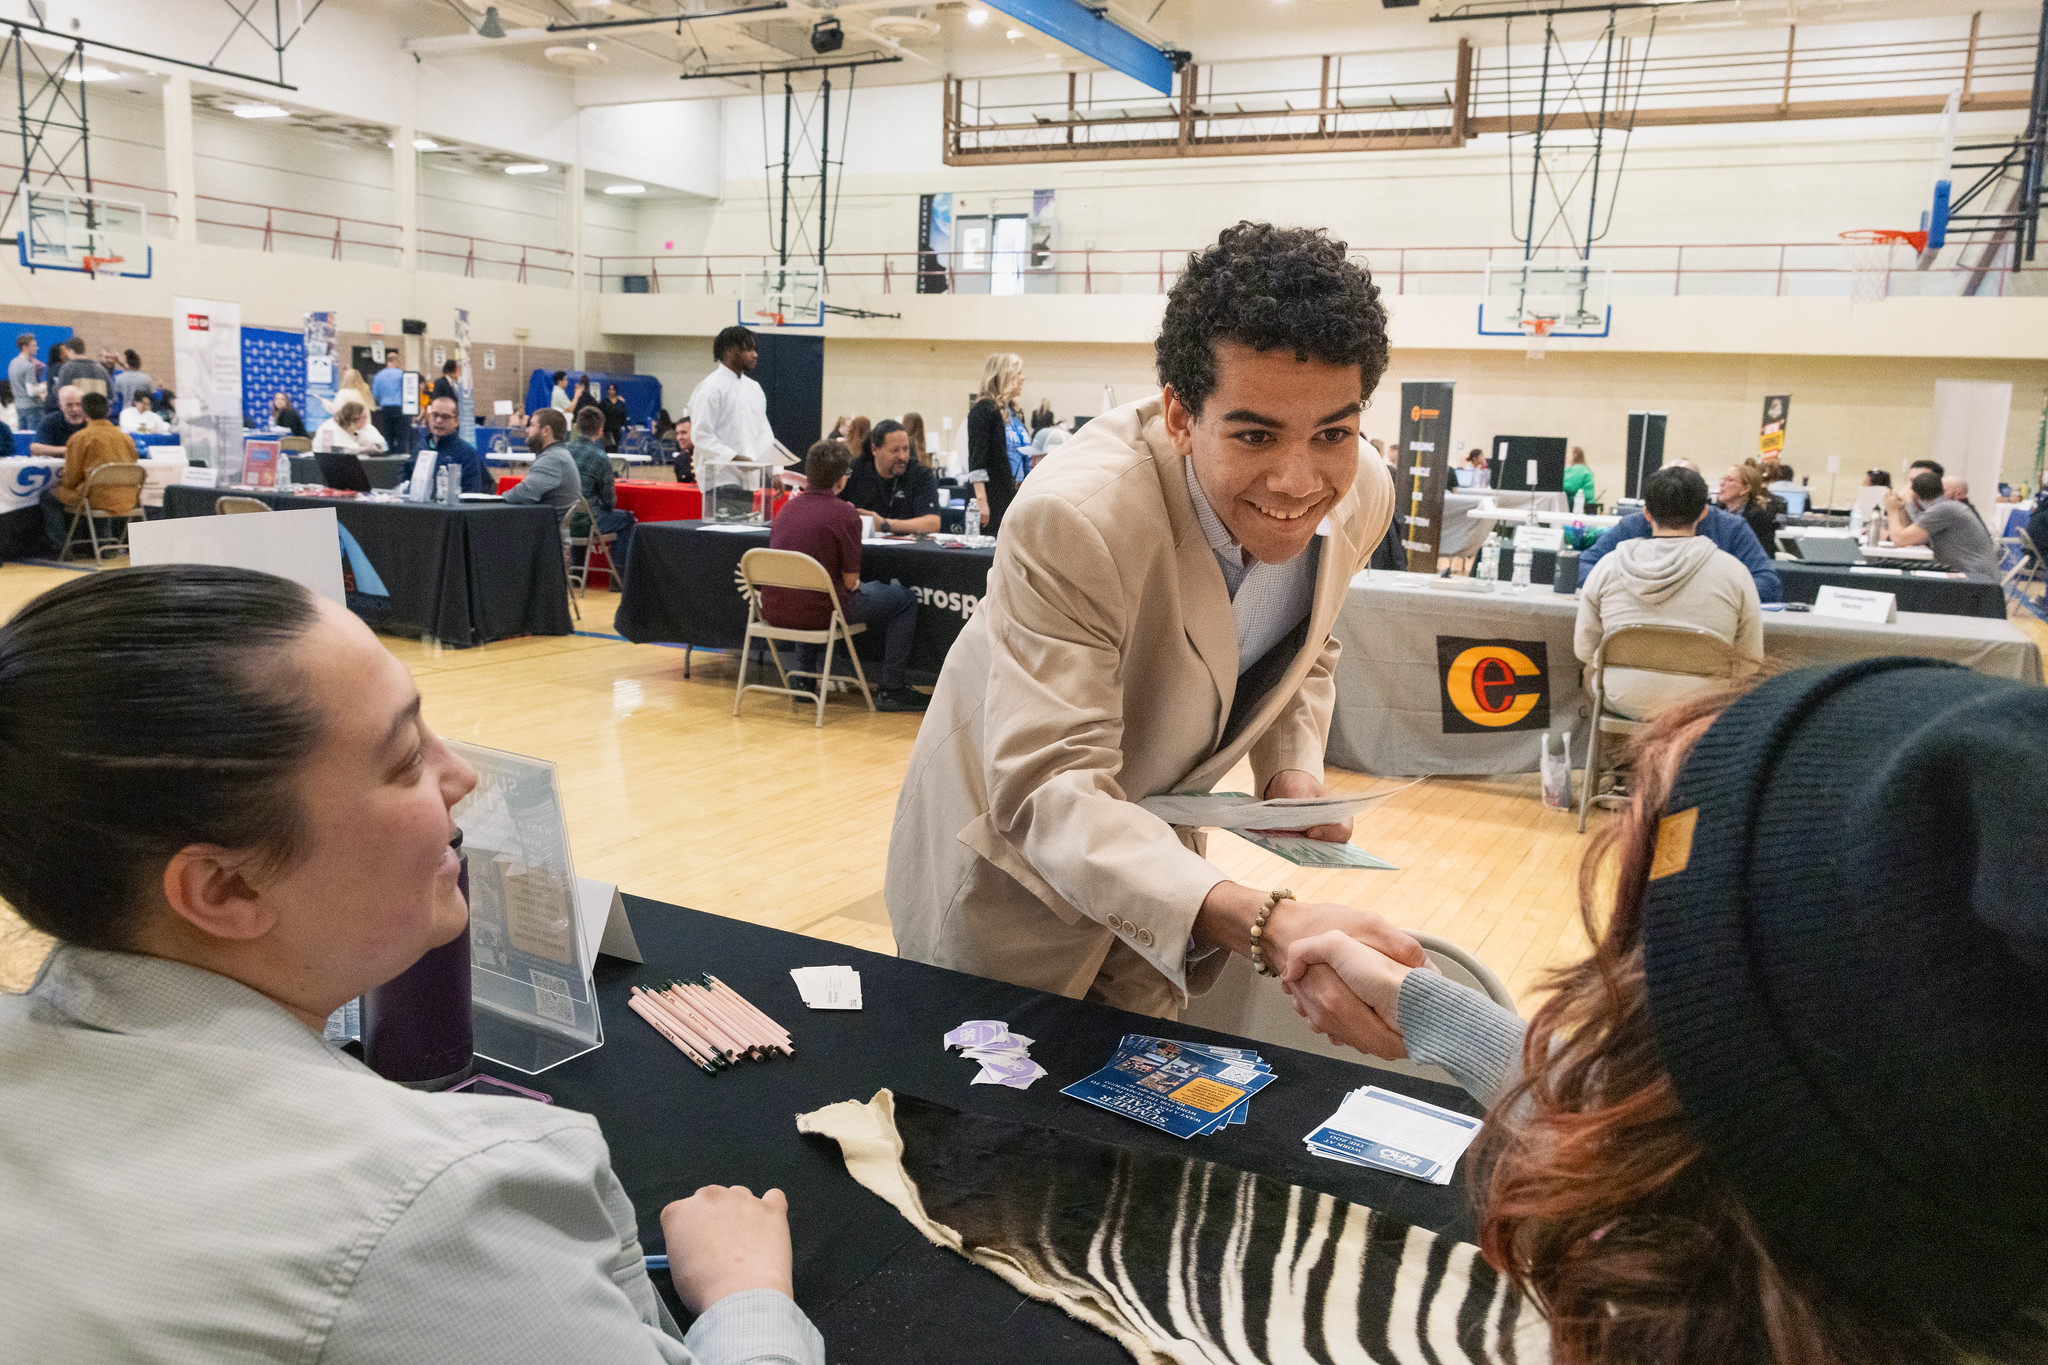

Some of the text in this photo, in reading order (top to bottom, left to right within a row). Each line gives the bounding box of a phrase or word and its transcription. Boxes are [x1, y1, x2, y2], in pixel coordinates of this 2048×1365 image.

[1100, 1084, 1123, 1093] PLACE
[1124, 1092, 1143, 1100] COOL
[1098, 1095, 1168, 1122] SUMMER
[1114, 1094, 1163, 1114] STAFF
[1174, 1106, 1197, 1115] WORK
[1180, 1113, 1201, 1122] WANT
[1337, 1143, 1361, 1152] WORK
